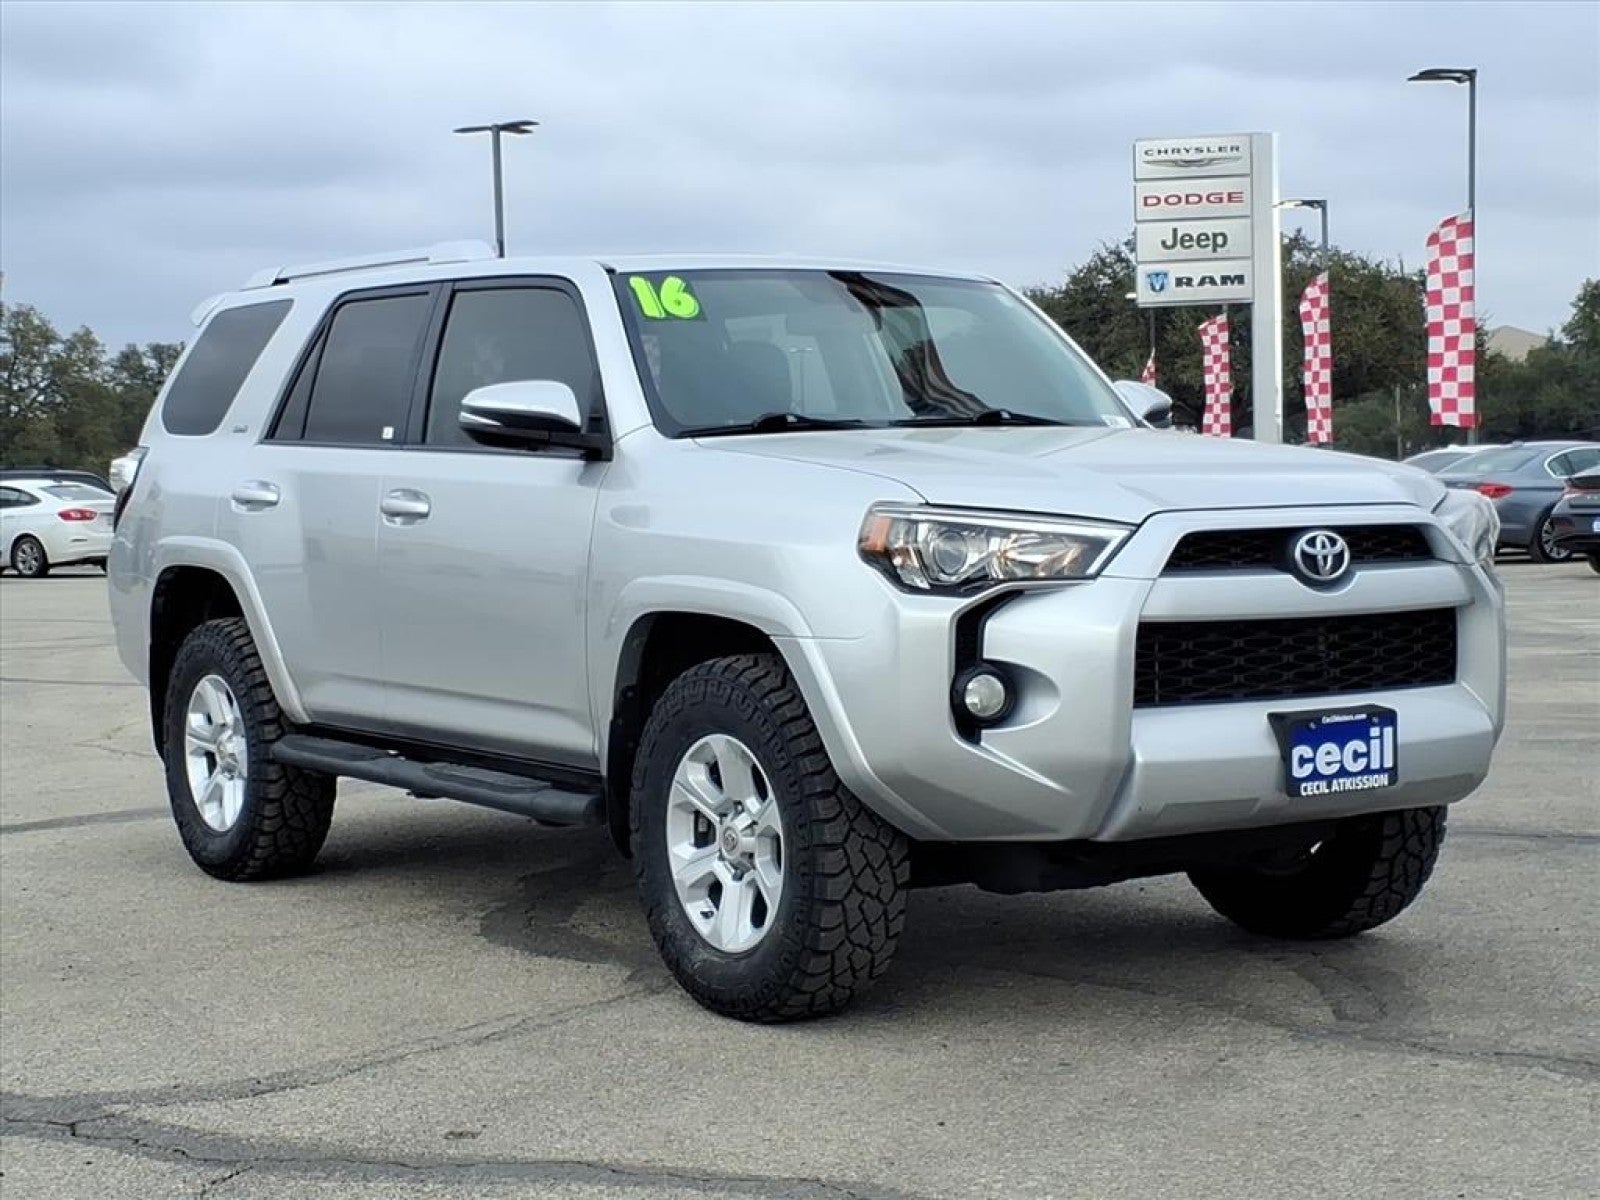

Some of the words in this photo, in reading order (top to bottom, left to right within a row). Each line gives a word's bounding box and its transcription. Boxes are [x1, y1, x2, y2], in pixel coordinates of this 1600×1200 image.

[1144, 145, 1240, 156] CHRYSLER
[1143, 191, 1244, 207] DODGE
[1160, 227, 1228, 253] Jeep
[1174, 274, 1245, 288] RAM
[629, 275, 700, 319] 16
[1292, 726, 1393, 779] cecil
[1301, 781, 1330, 796] CECIL
